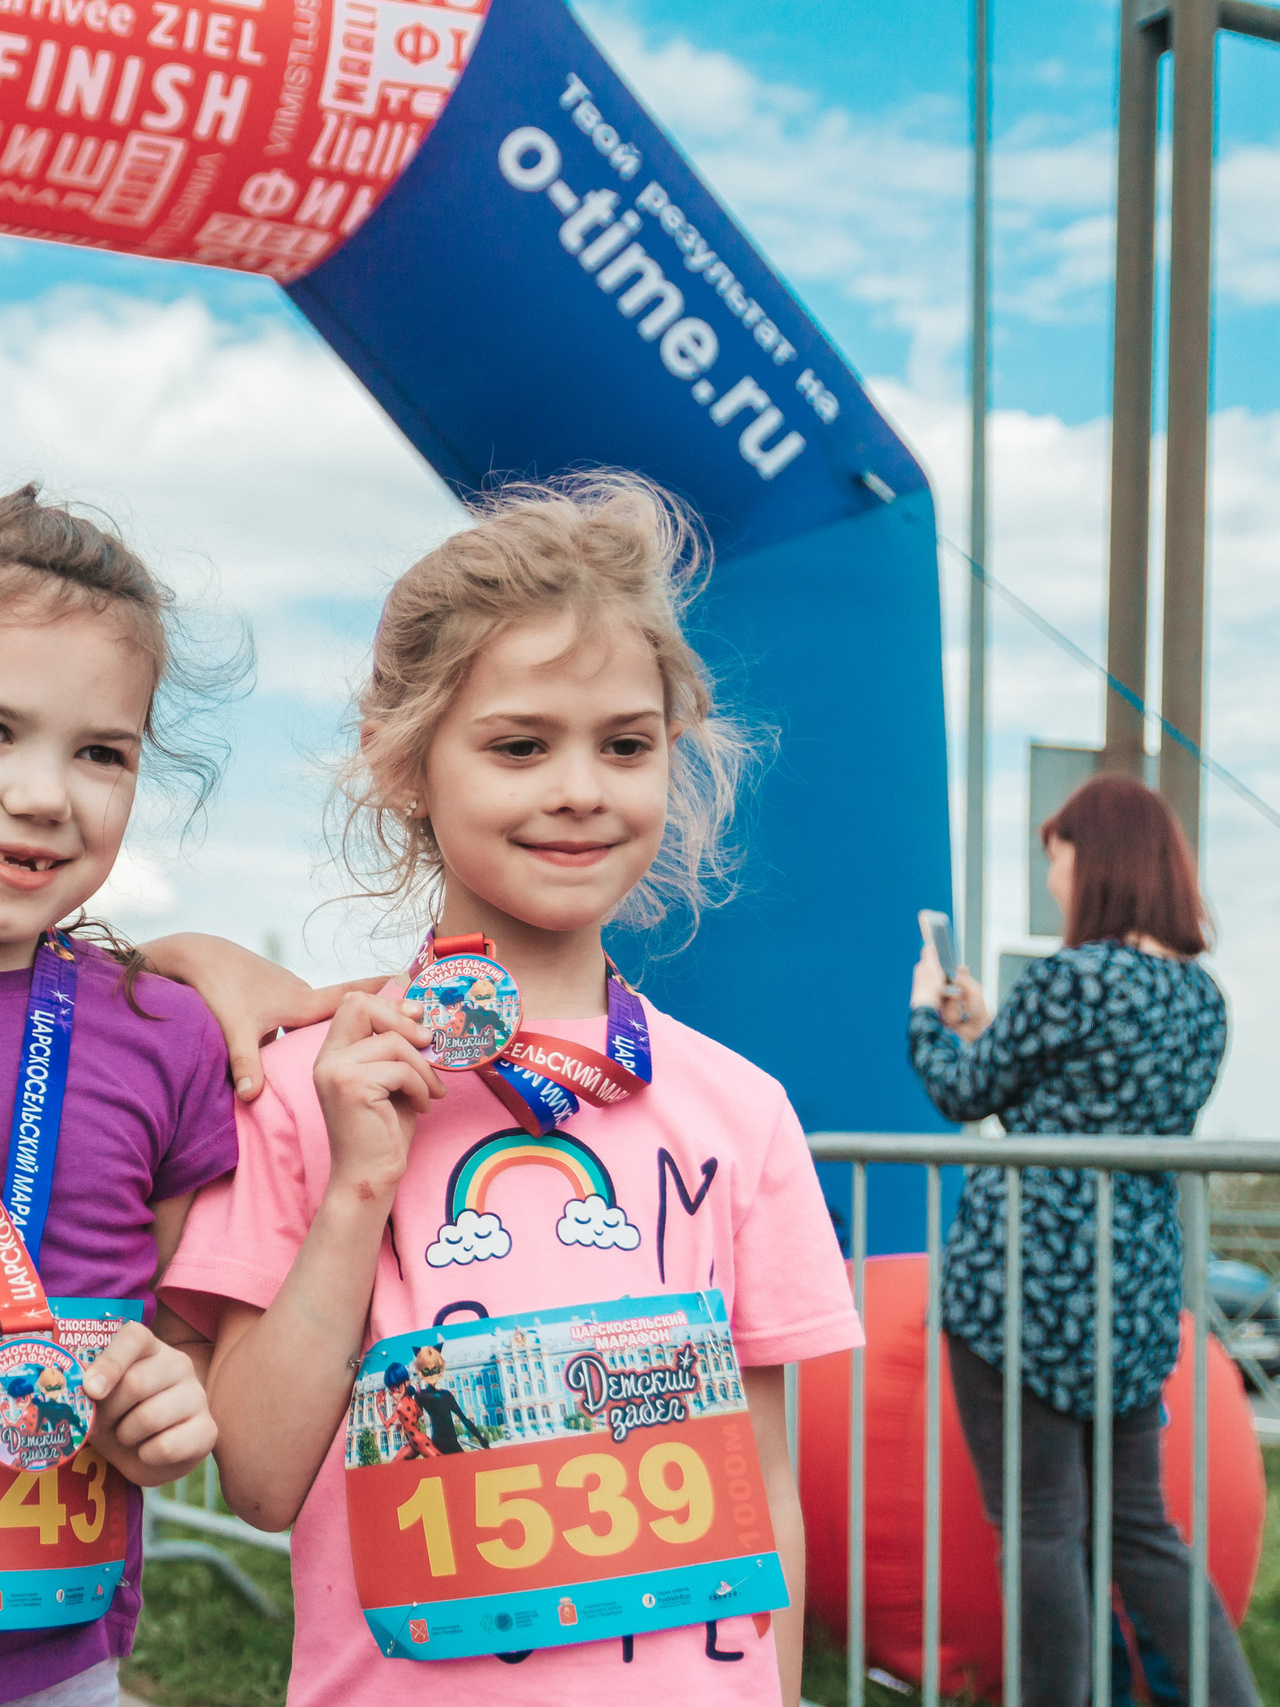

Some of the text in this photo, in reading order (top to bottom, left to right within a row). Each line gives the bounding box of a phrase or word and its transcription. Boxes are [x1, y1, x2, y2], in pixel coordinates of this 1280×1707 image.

[149, 2, 264, 63] ZIEL
[558, 72, 841, 425] Твой результат на
[497, 125, 807, 481] o-time.ru
[419, 960, 503, 986] ЦАРСКОСЕЛЬСКИЙ
[435, 969, 485, 982] МАРАФОН
[15, 1010, 55, 1173] ЦАРСКОСЕЛЬСКИЙ
[572, 1312, 687, 1339] ЦАРСКОСЕЛЬСКИЙ
[596, 1329, 669, 1350] МАРАФОН
[0, 1354, 52, 1371] МАРАФОН
[569, 1347, 696, 1412] Детский
[611, 1394, 685, 1440] забег
[2, 1425, 66, 1453] Детский
[21, 1447, 59, 1467] забег
[397, 1442, 715, 1577] 1539
